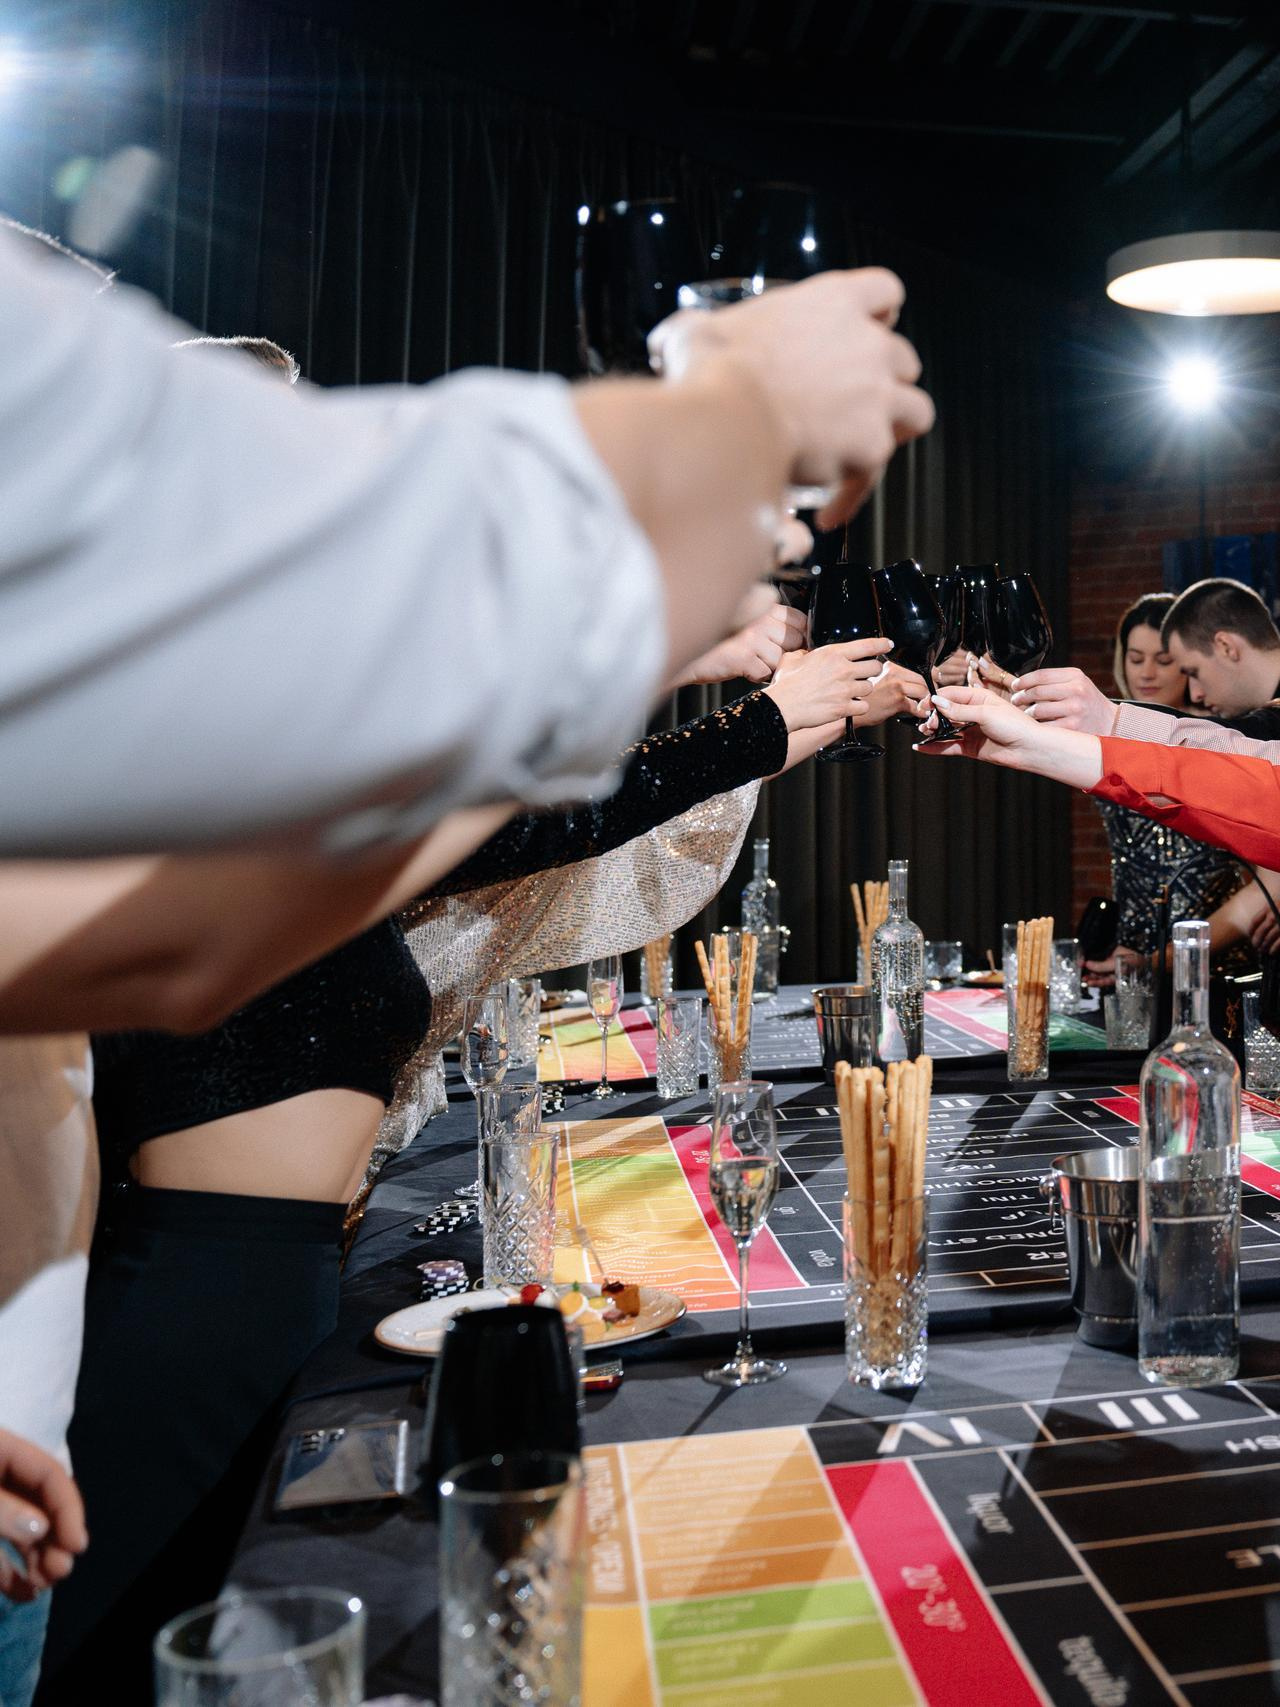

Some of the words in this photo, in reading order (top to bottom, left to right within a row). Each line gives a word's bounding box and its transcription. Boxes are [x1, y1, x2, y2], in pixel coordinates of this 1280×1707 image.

[927, 1149, 995, 1159] SPRIT
[942, 1163, 996, 1173] FIZZ
[981, 1193, 1036, 1203] TINI
[1097, 1393, 1202, 1429] III
[876, 1415, 983, 1455] IV
